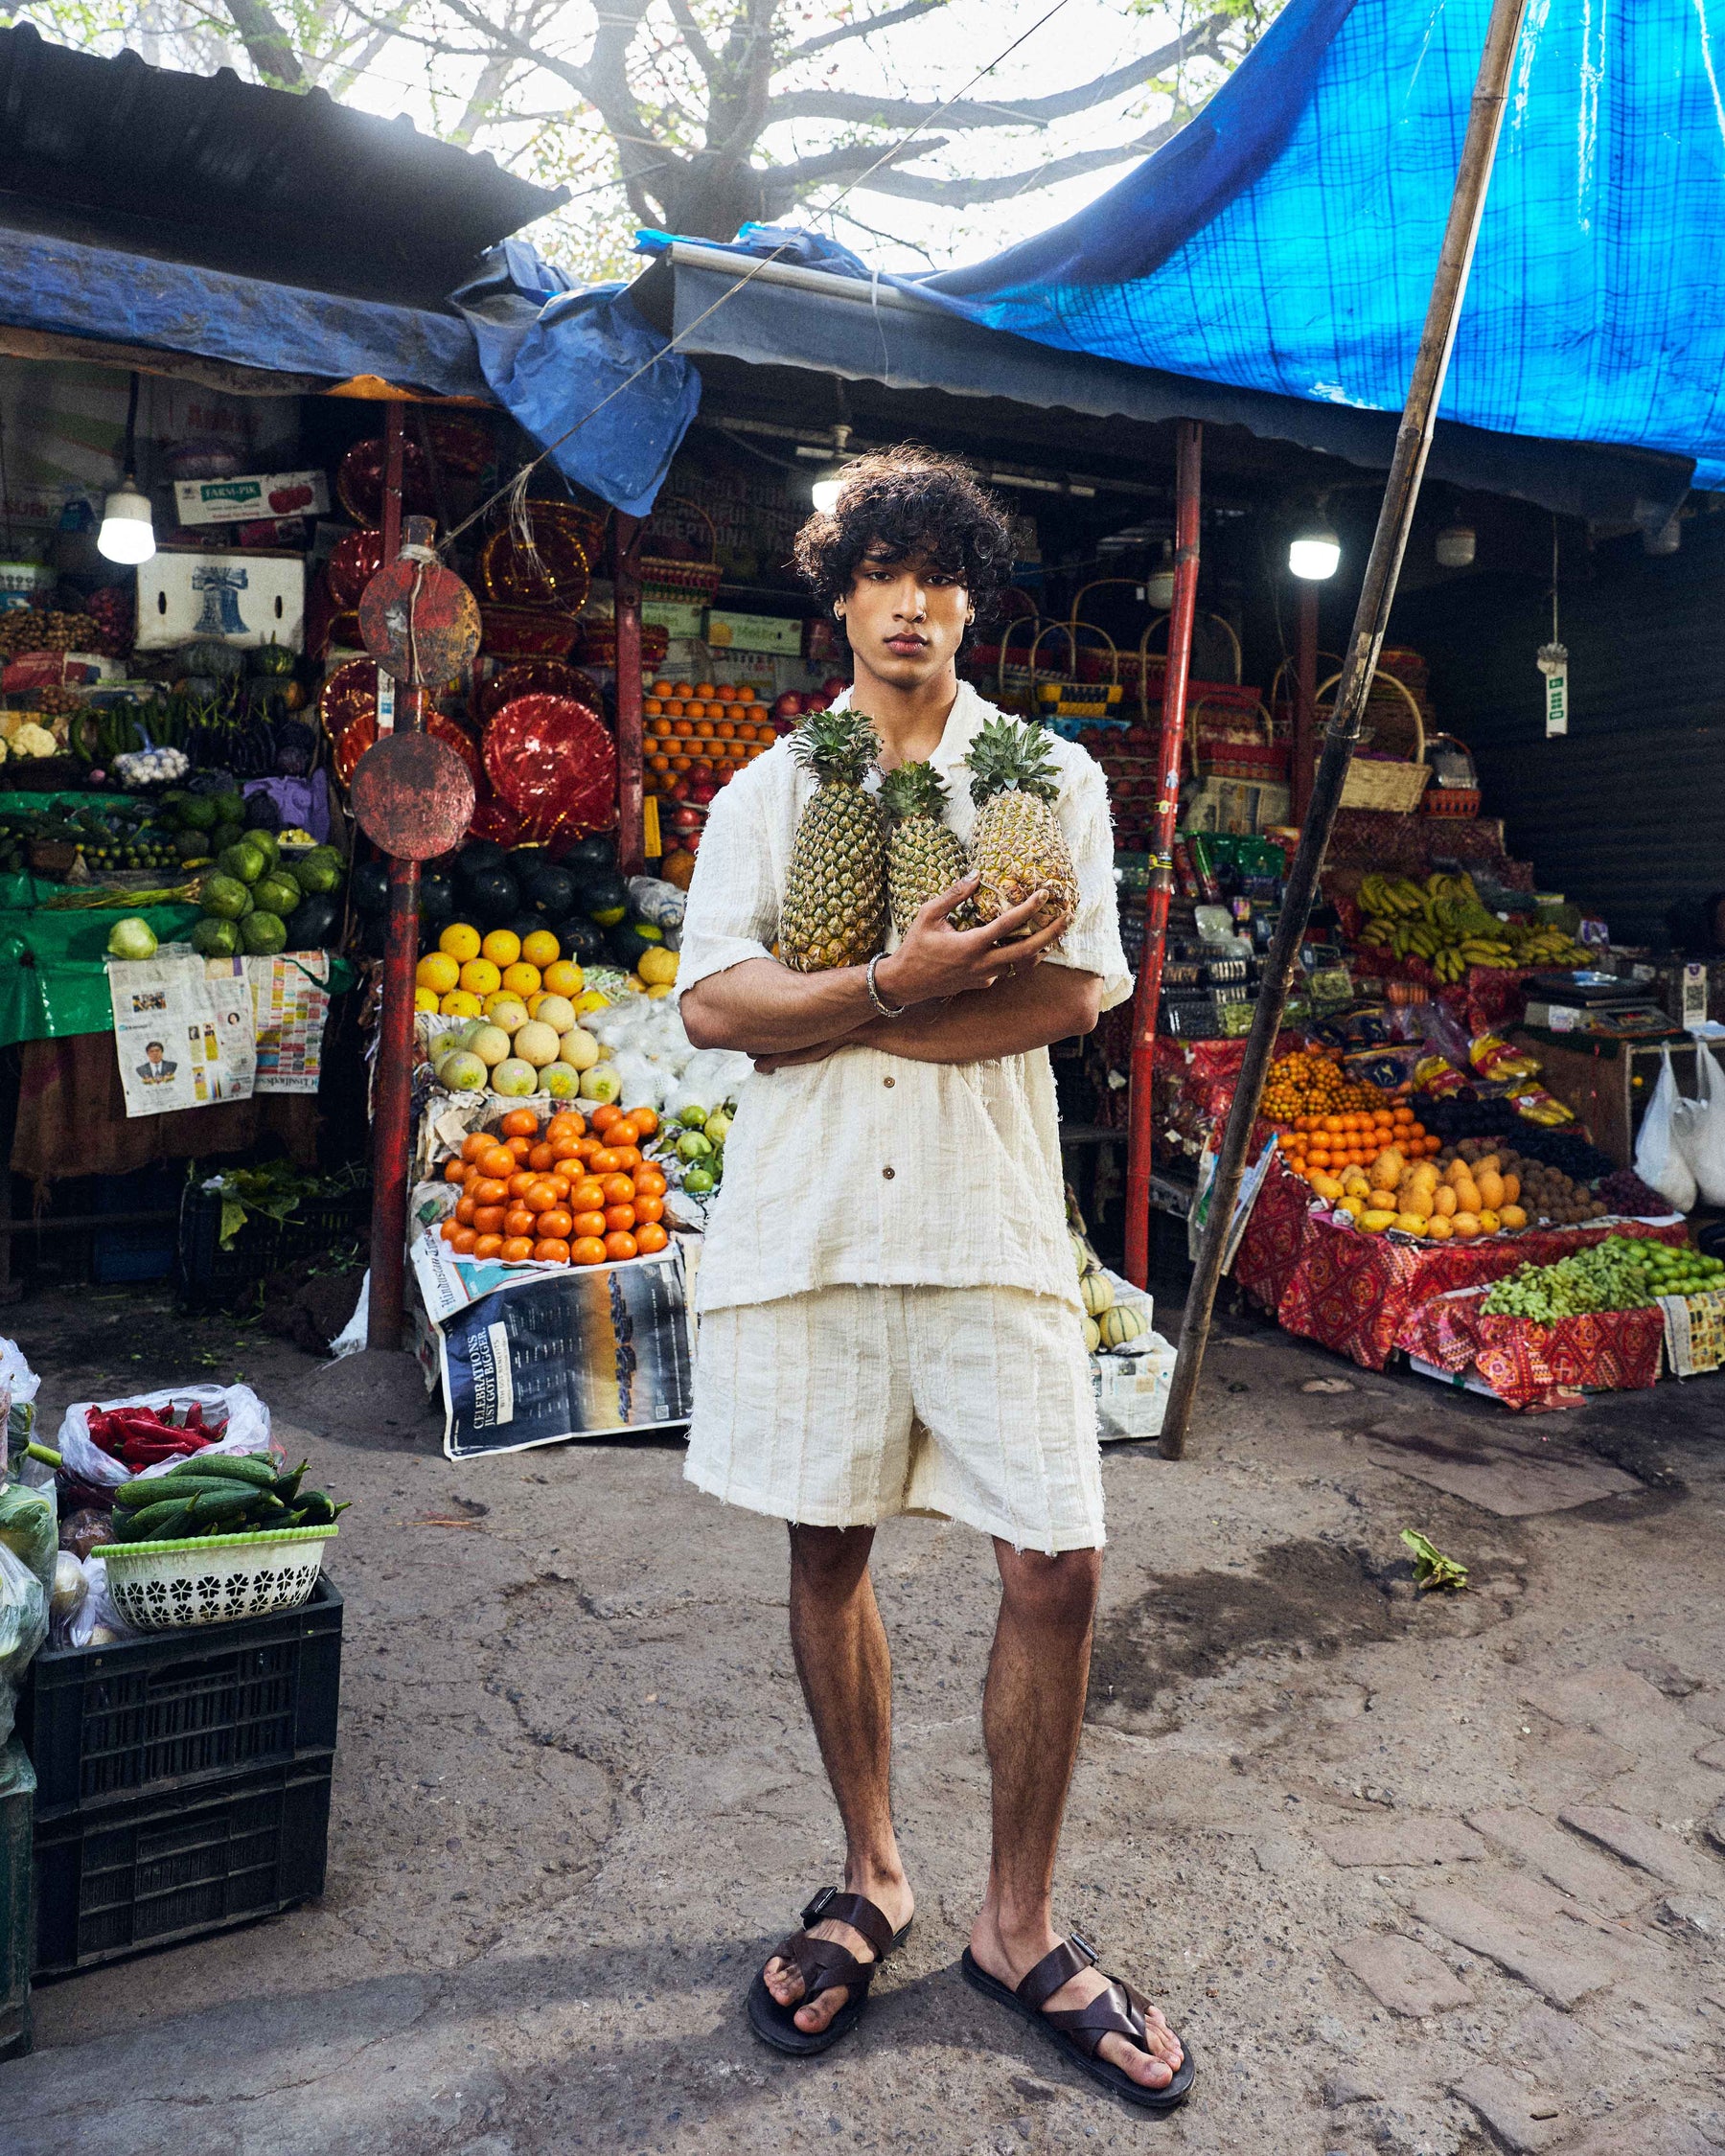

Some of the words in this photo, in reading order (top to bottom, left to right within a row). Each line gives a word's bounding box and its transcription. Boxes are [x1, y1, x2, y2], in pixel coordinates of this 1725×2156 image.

[431, 1257, 456, 1308] Hindustan
[477, 1327, 494, 1376] BIGGER.
[468, 1335, 485, 1430] CELEBRATIONS
[486, 1377, 495, 1402] GOT
[485, 1403, 495, 1427] JUST
